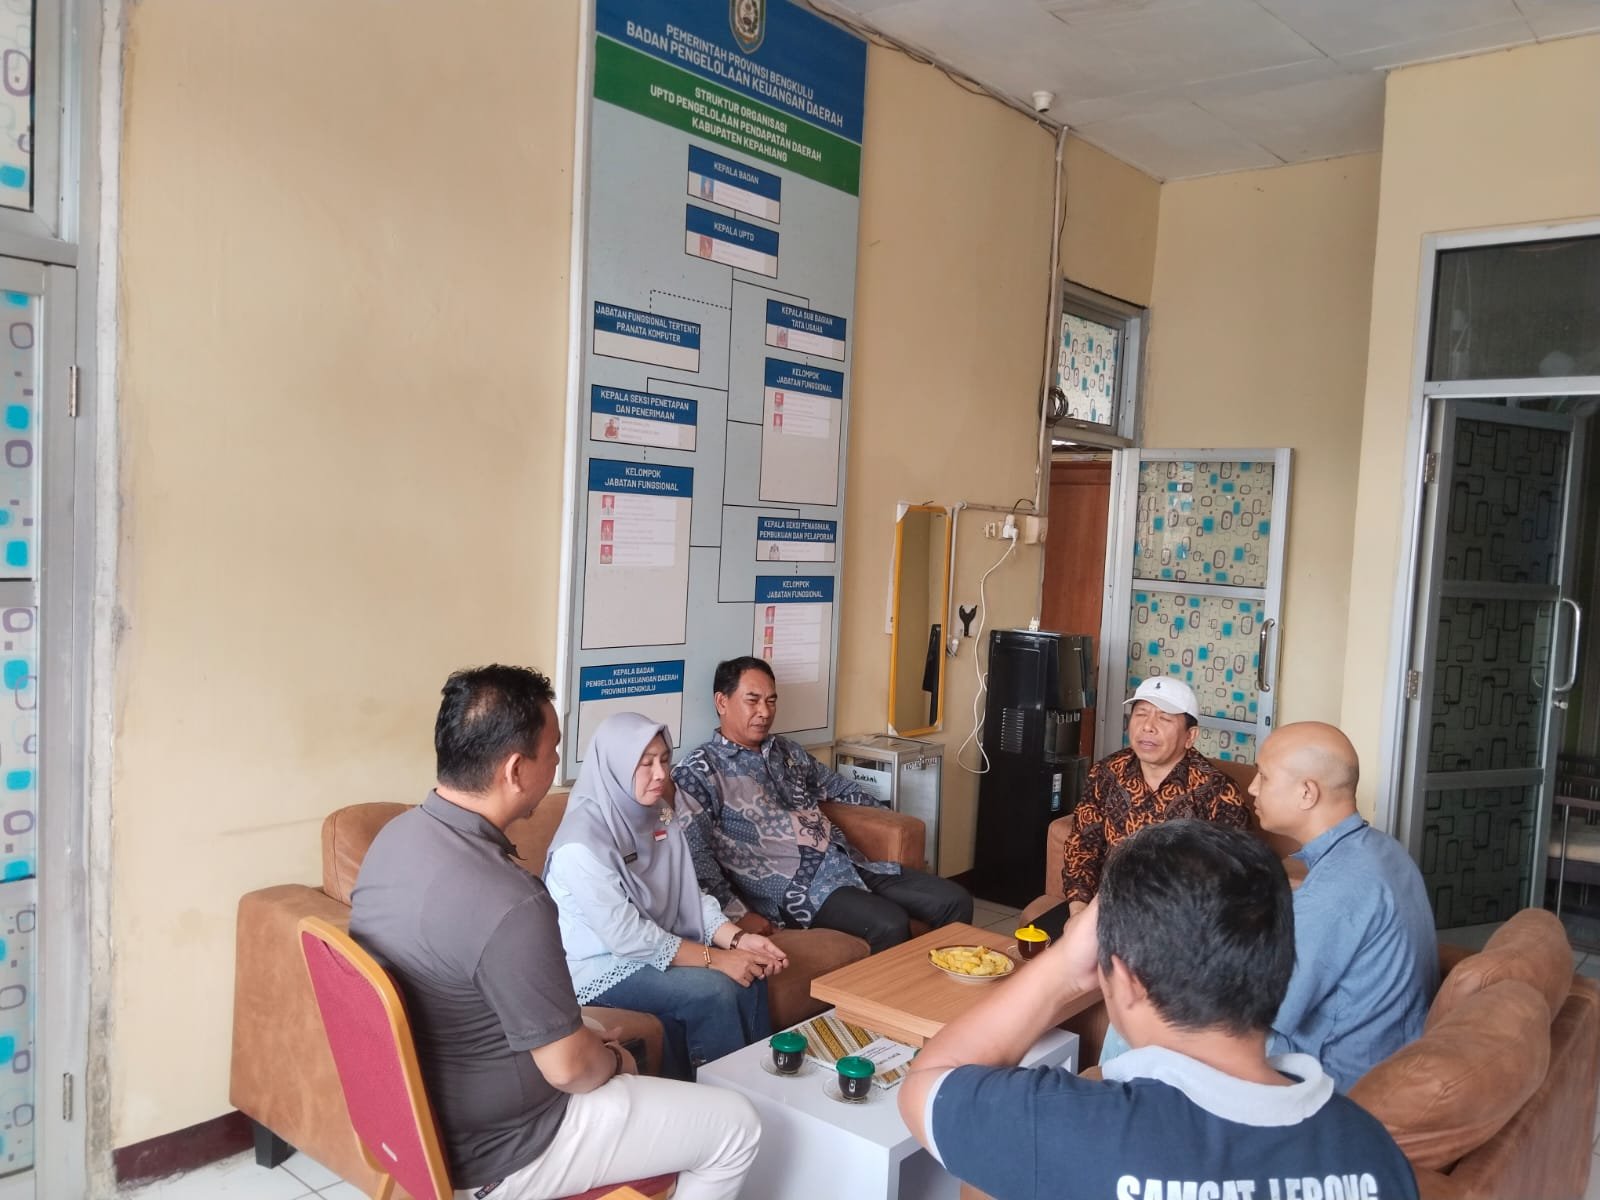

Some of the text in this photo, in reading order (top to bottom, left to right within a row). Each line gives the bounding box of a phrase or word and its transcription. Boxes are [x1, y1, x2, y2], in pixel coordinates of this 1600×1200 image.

[666, 24, 813, 99] PEMERINTAH PROVINSI BENGKULU
[627, 21, 843, 127] BADAN PENGELOLAAN KEUANGAN DAERAH
[695, 87, 787, 133] STRUKTUR ORGANISASI
[650, 84, 821, 162] UPTD PENGELOLAAN PENDAPATAN DAERAH
[692, 118, 787, 162] KABUPATEN KEPAHIANG
[714, 161, 759, 184] KEPALA BADAN
[714, 222, 755, 242] KEPALA UPTD
[596, 305, 699, 335] JABATAN FUNGSIONAL TERTENTU
[782, 306, 833, 326] KEPALA SUB BAGIAN
[616, 322, 680, 343] PRANATA KOMPUTER
[792, 320, 823, 333] TATA USAHA
[792, 368, 819, 380] KELOMPOK
[777, 376, 832, 392] JABATAN FUNGSIONAL
[601, 390, 689, 410] KEPALA SEKSI PENETAPAN
[616, 405, 675, 420] DAN PENERIMAAN
[625, 467, 661, 478] KELOMPOK
[605, 478, 679, 491] JABATAN FUNGSIONAL
[764, 520, 785, 529] KEPALA
[786, 521, 800, 529] SEKSI
[759, 530, 834, 541] PEMBUKUAN DAN PELAPORAN
[766, 590, 823, 598] JABATAN FUNGSIONAL
[613, 668, 635, 676] KEPALA
[586, 674, 679, 688] PENGELOLAAN KEUANGAN DAERAH
[601, 685, 656, 696] PROVINSI BENGKULU
